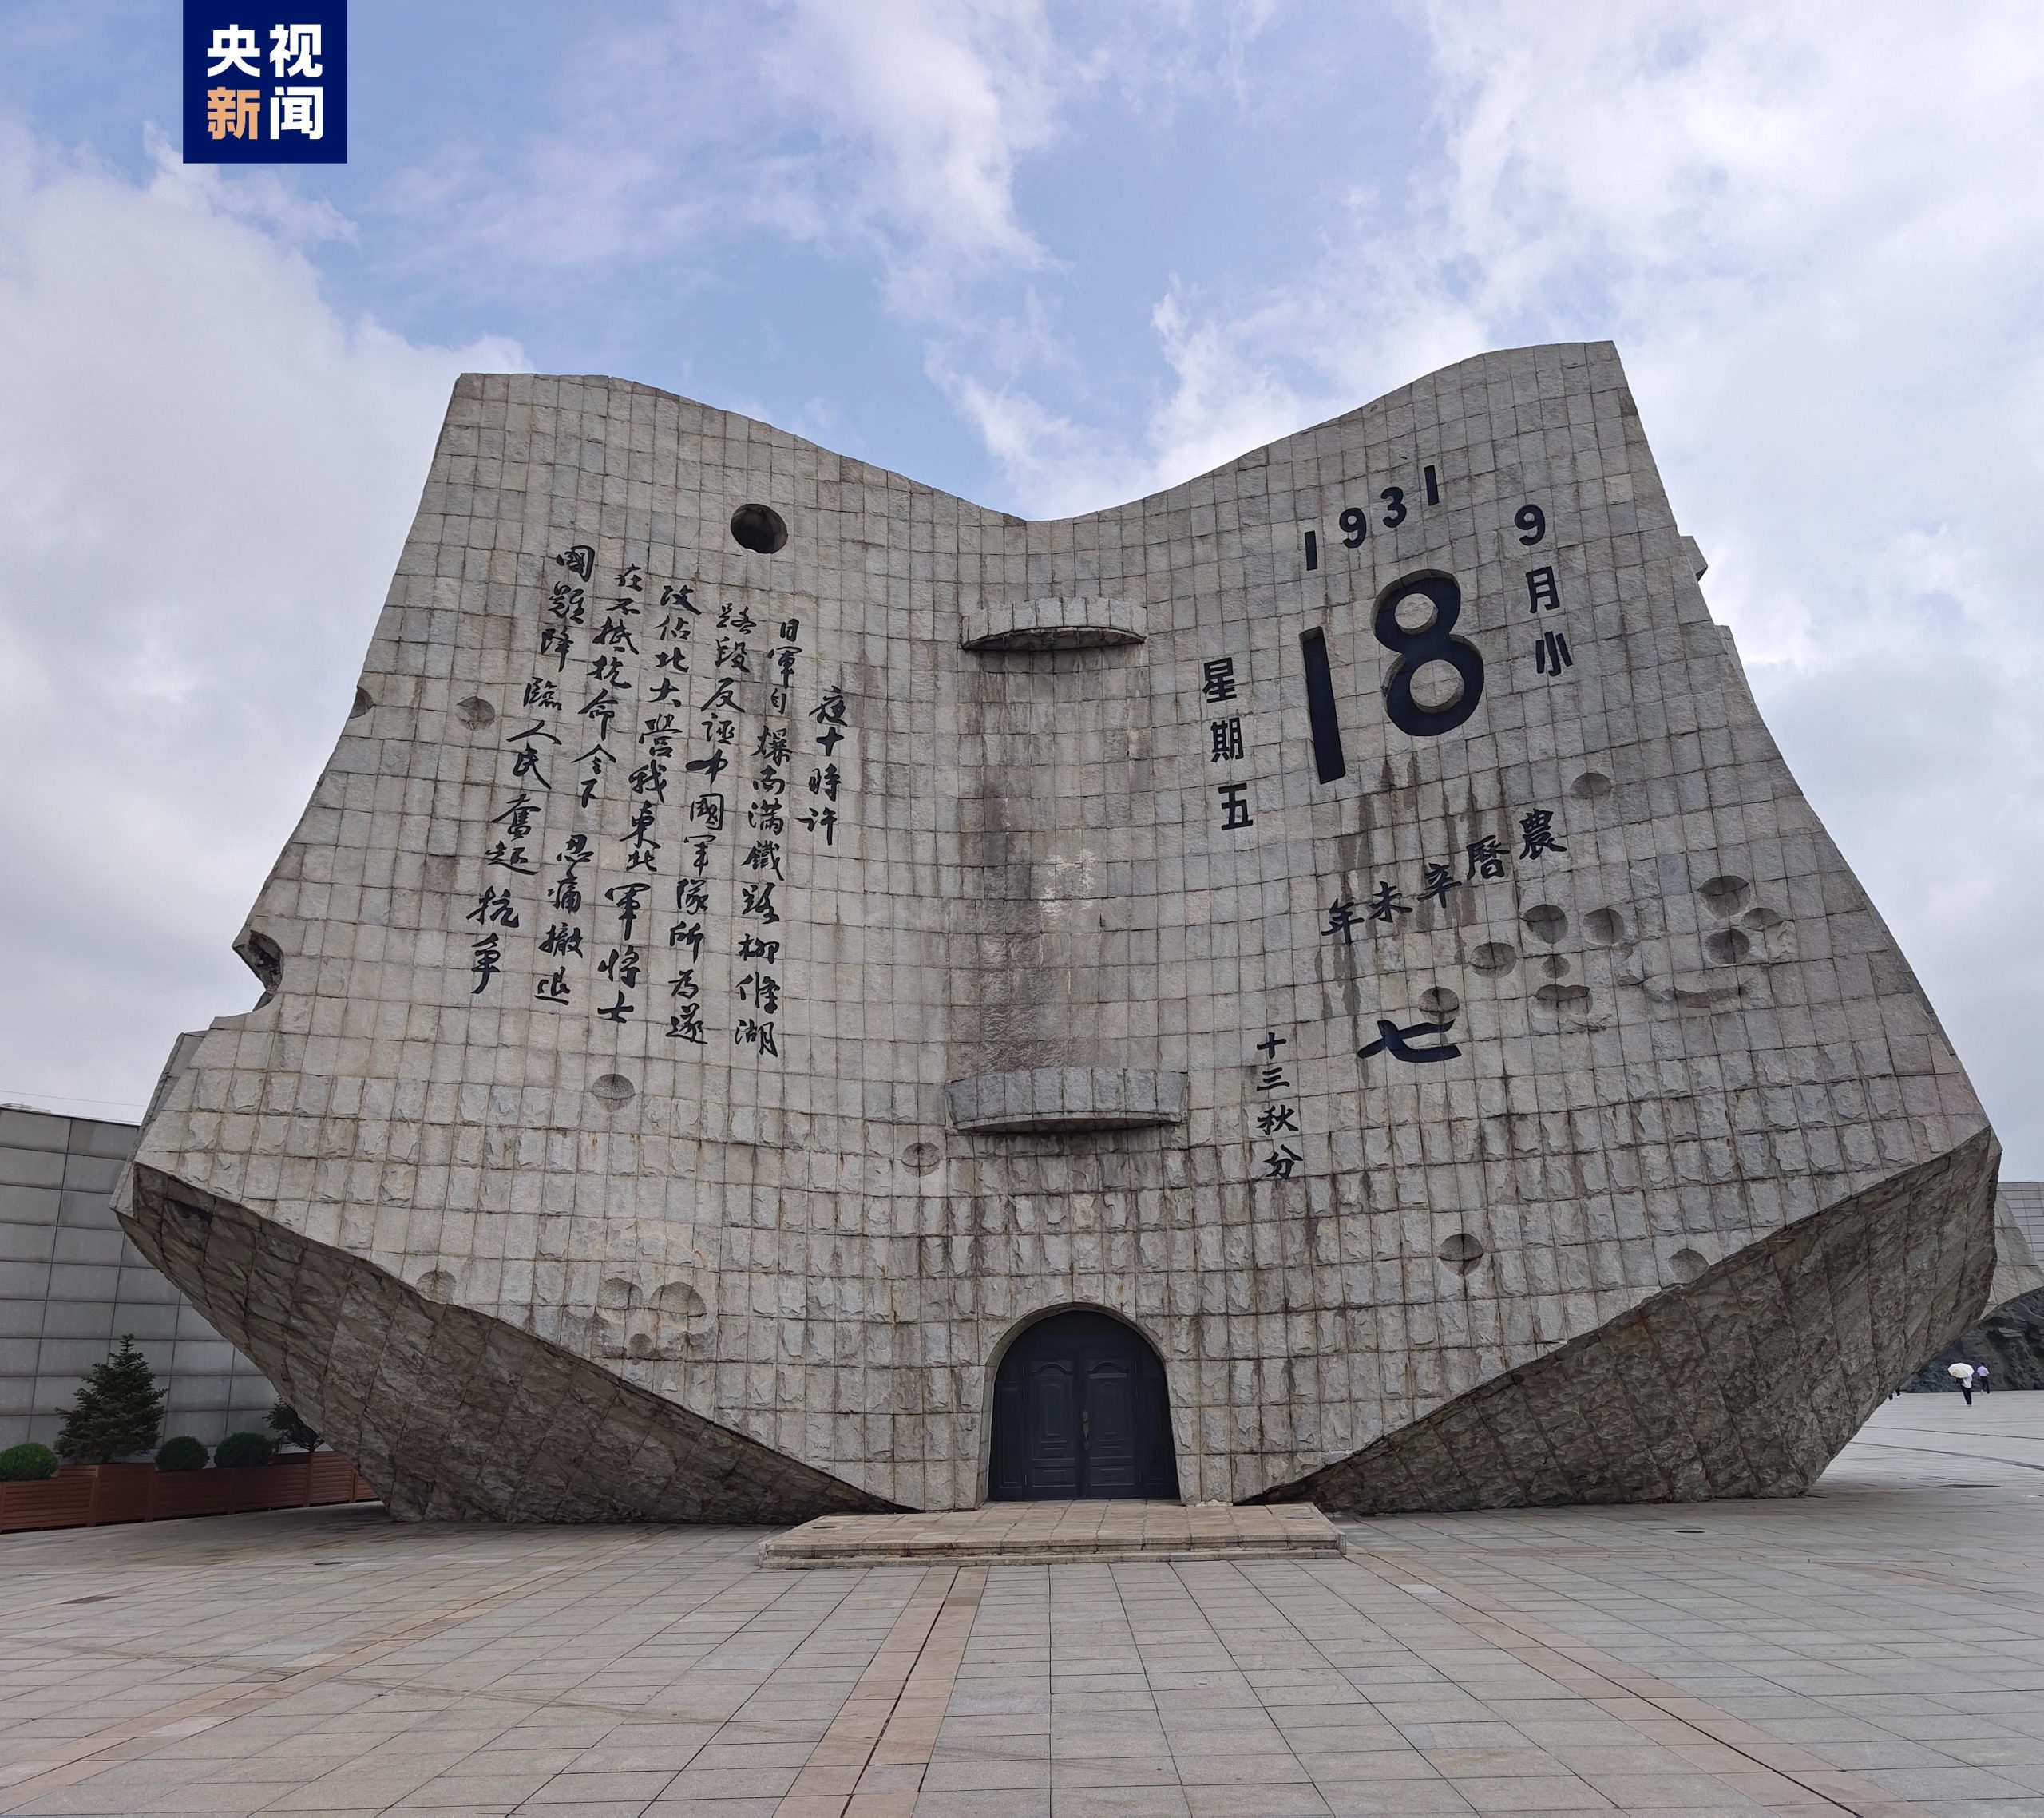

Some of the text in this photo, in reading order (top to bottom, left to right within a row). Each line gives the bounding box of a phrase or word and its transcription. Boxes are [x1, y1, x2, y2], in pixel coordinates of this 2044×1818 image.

[1304, 465, 1440, 571] 1931
[1514, 504, 1573, 677] 9月小
[1202, 657, 1254, 830] 星期五
[1299, 568, 1484, 784] 18
[798, 685, 848, 846] 夜十時許
[1256, 1032, 1302, 1180] 十三秋分
[1357, 1019, 1462, 1063] 七
